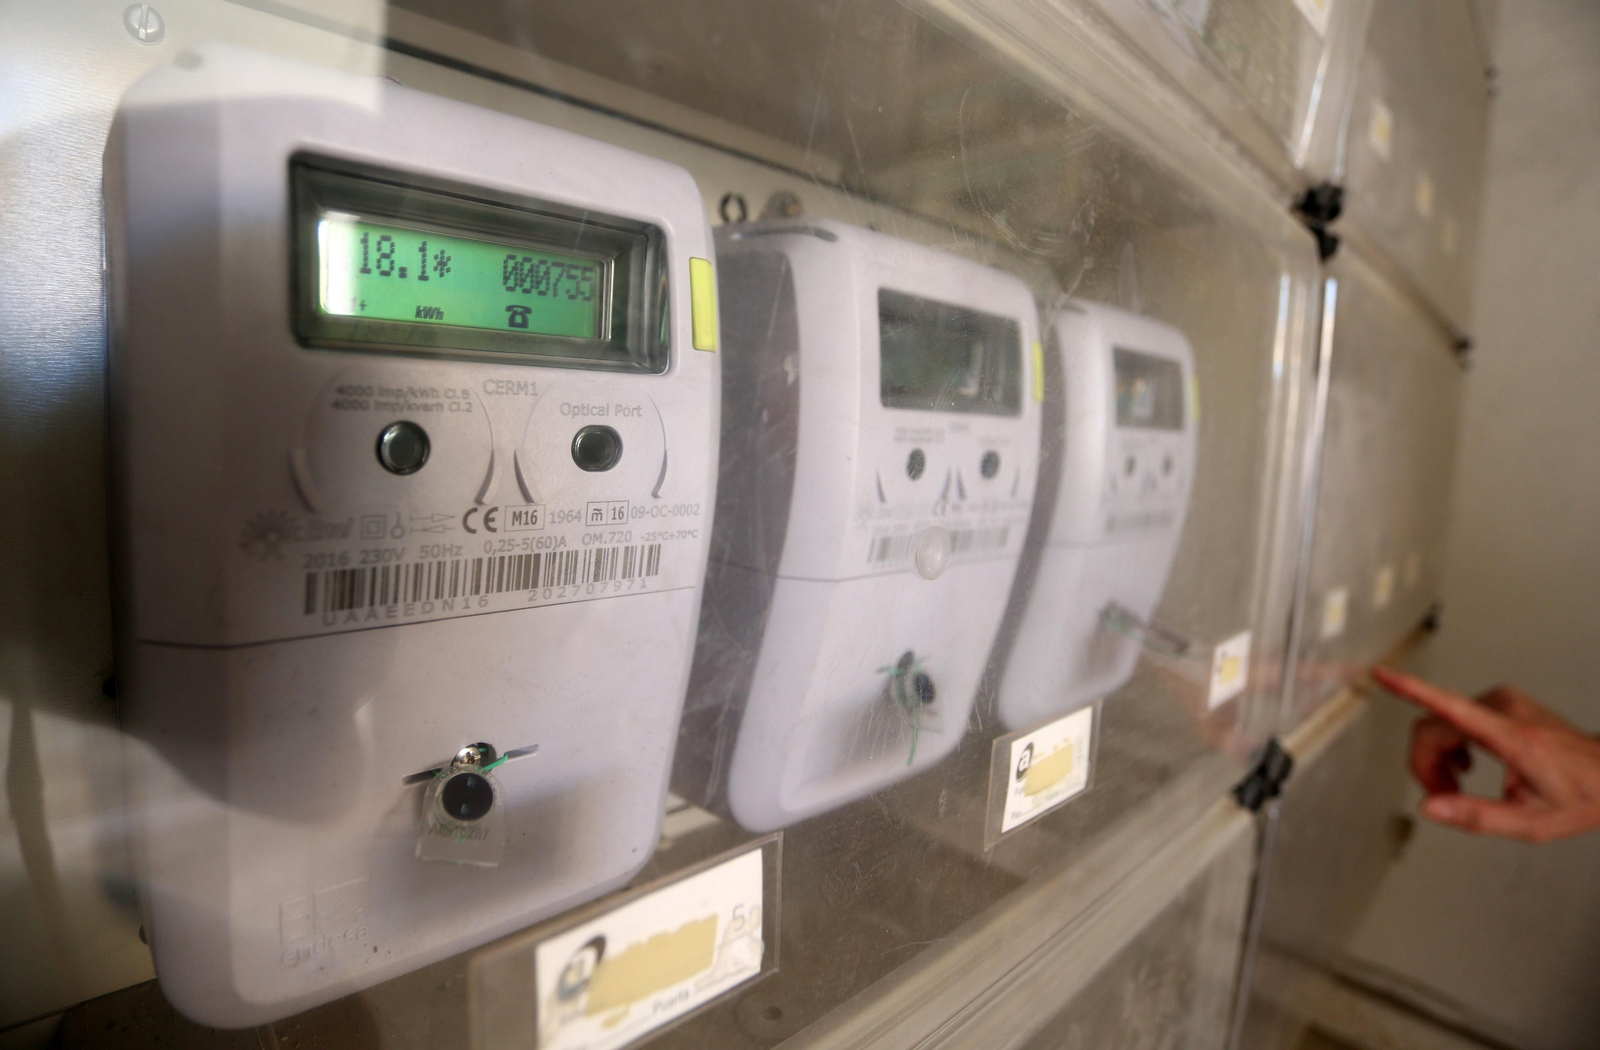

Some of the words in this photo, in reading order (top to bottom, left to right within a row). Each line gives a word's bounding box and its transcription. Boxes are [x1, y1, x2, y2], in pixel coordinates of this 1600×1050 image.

[503, 254, 596, 302] 000755
[414, 305, 445, 321] kWh
[482, 379, 539, 397] CERM1
[559, 402, 610, 419] Optical
[614, 403, 643, 418] Port
[511, 509, 539, 527] M16
[550, 509, 583, 525] 1964
[611, 506, 626, 521] 16
[630, 503, 701, 519] 09-OC-0002
[302, 550, 351, 570] 2016
[359, 546, 406, 566] 230V
[419, 543, 464, 560] 50Hz
